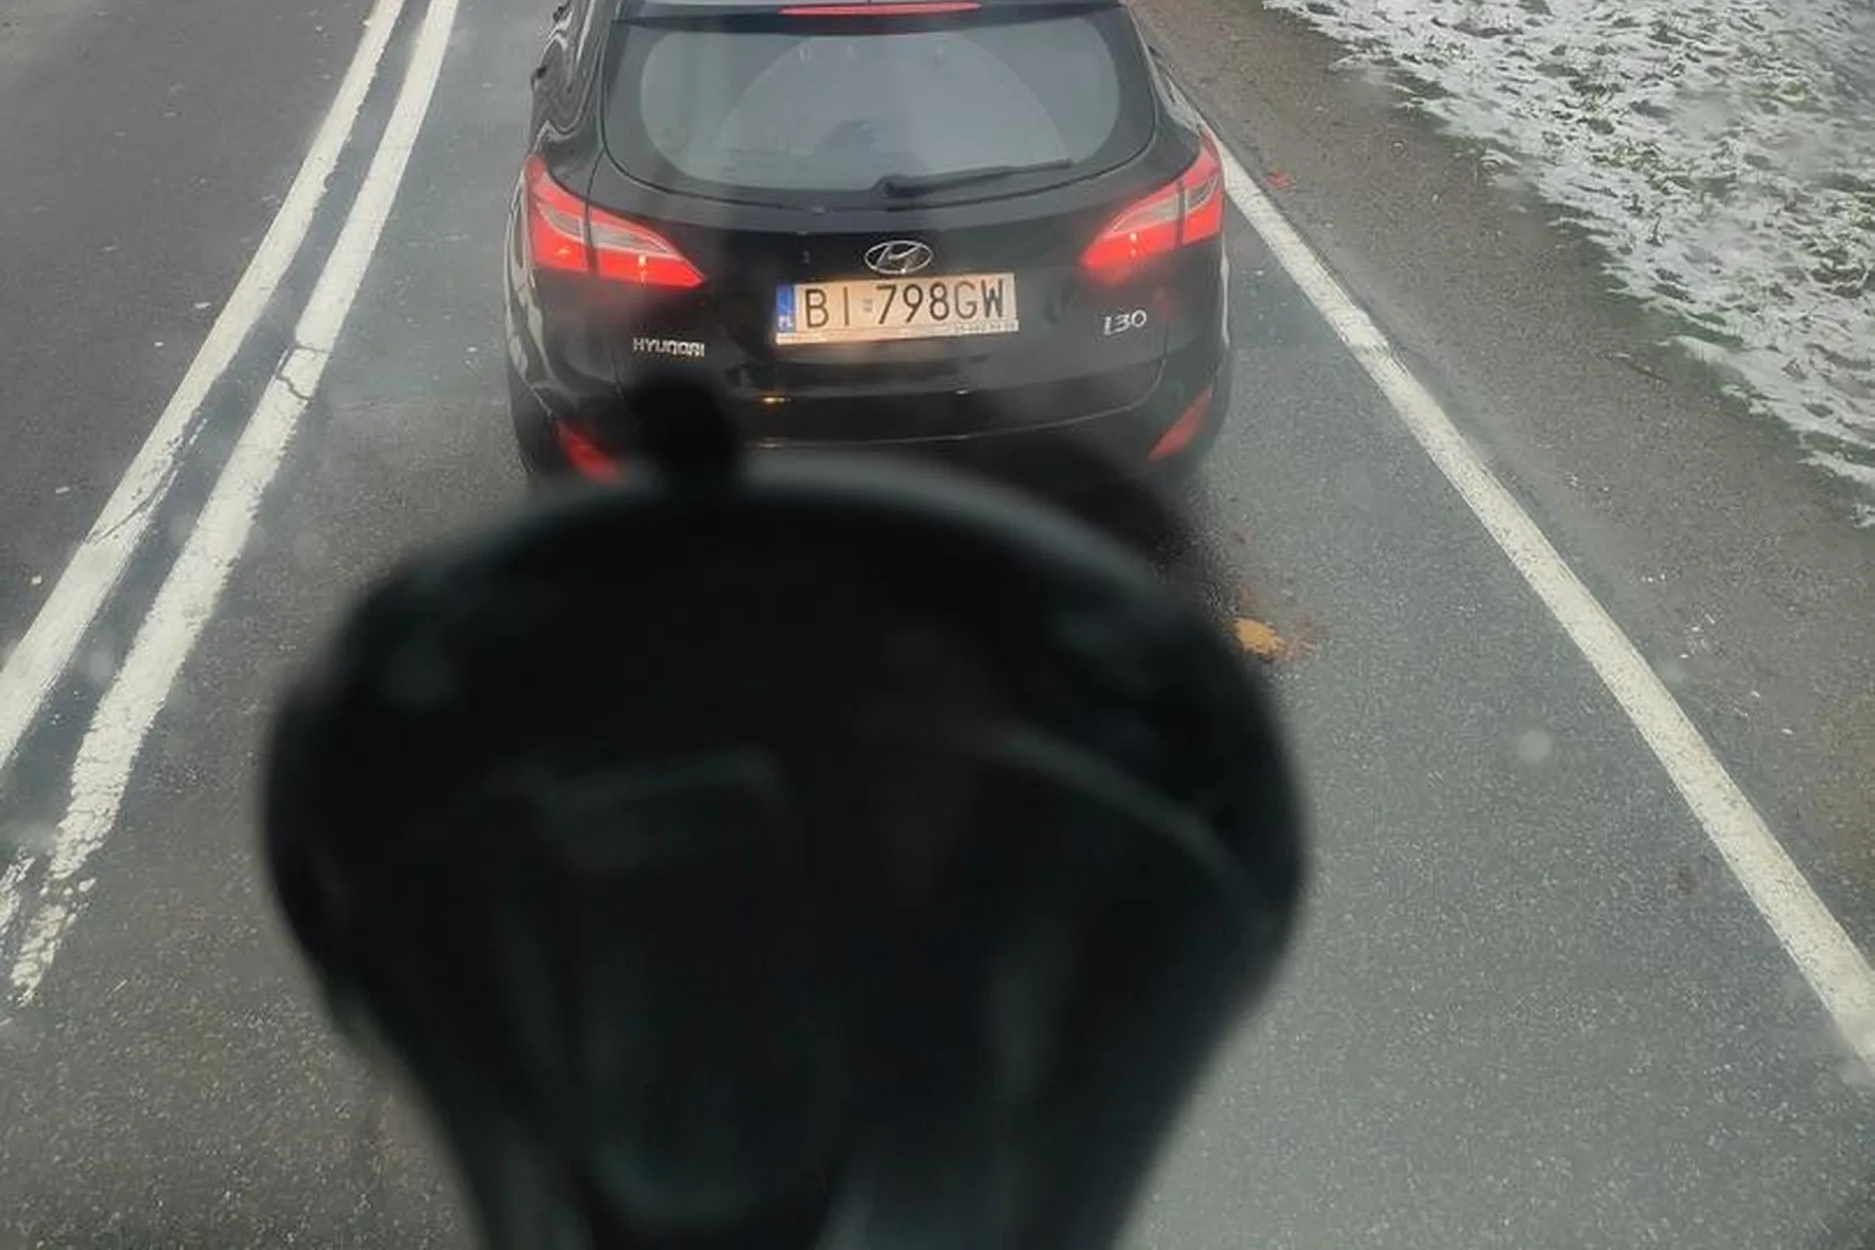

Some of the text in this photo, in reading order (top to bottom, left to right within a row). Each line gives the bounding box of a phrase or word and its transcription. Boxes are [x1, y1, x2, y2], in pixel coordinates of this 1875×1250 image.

[804, 278, 1004, 329] BI 798GW
[632, 337, 706, 357] HYUNDAI
